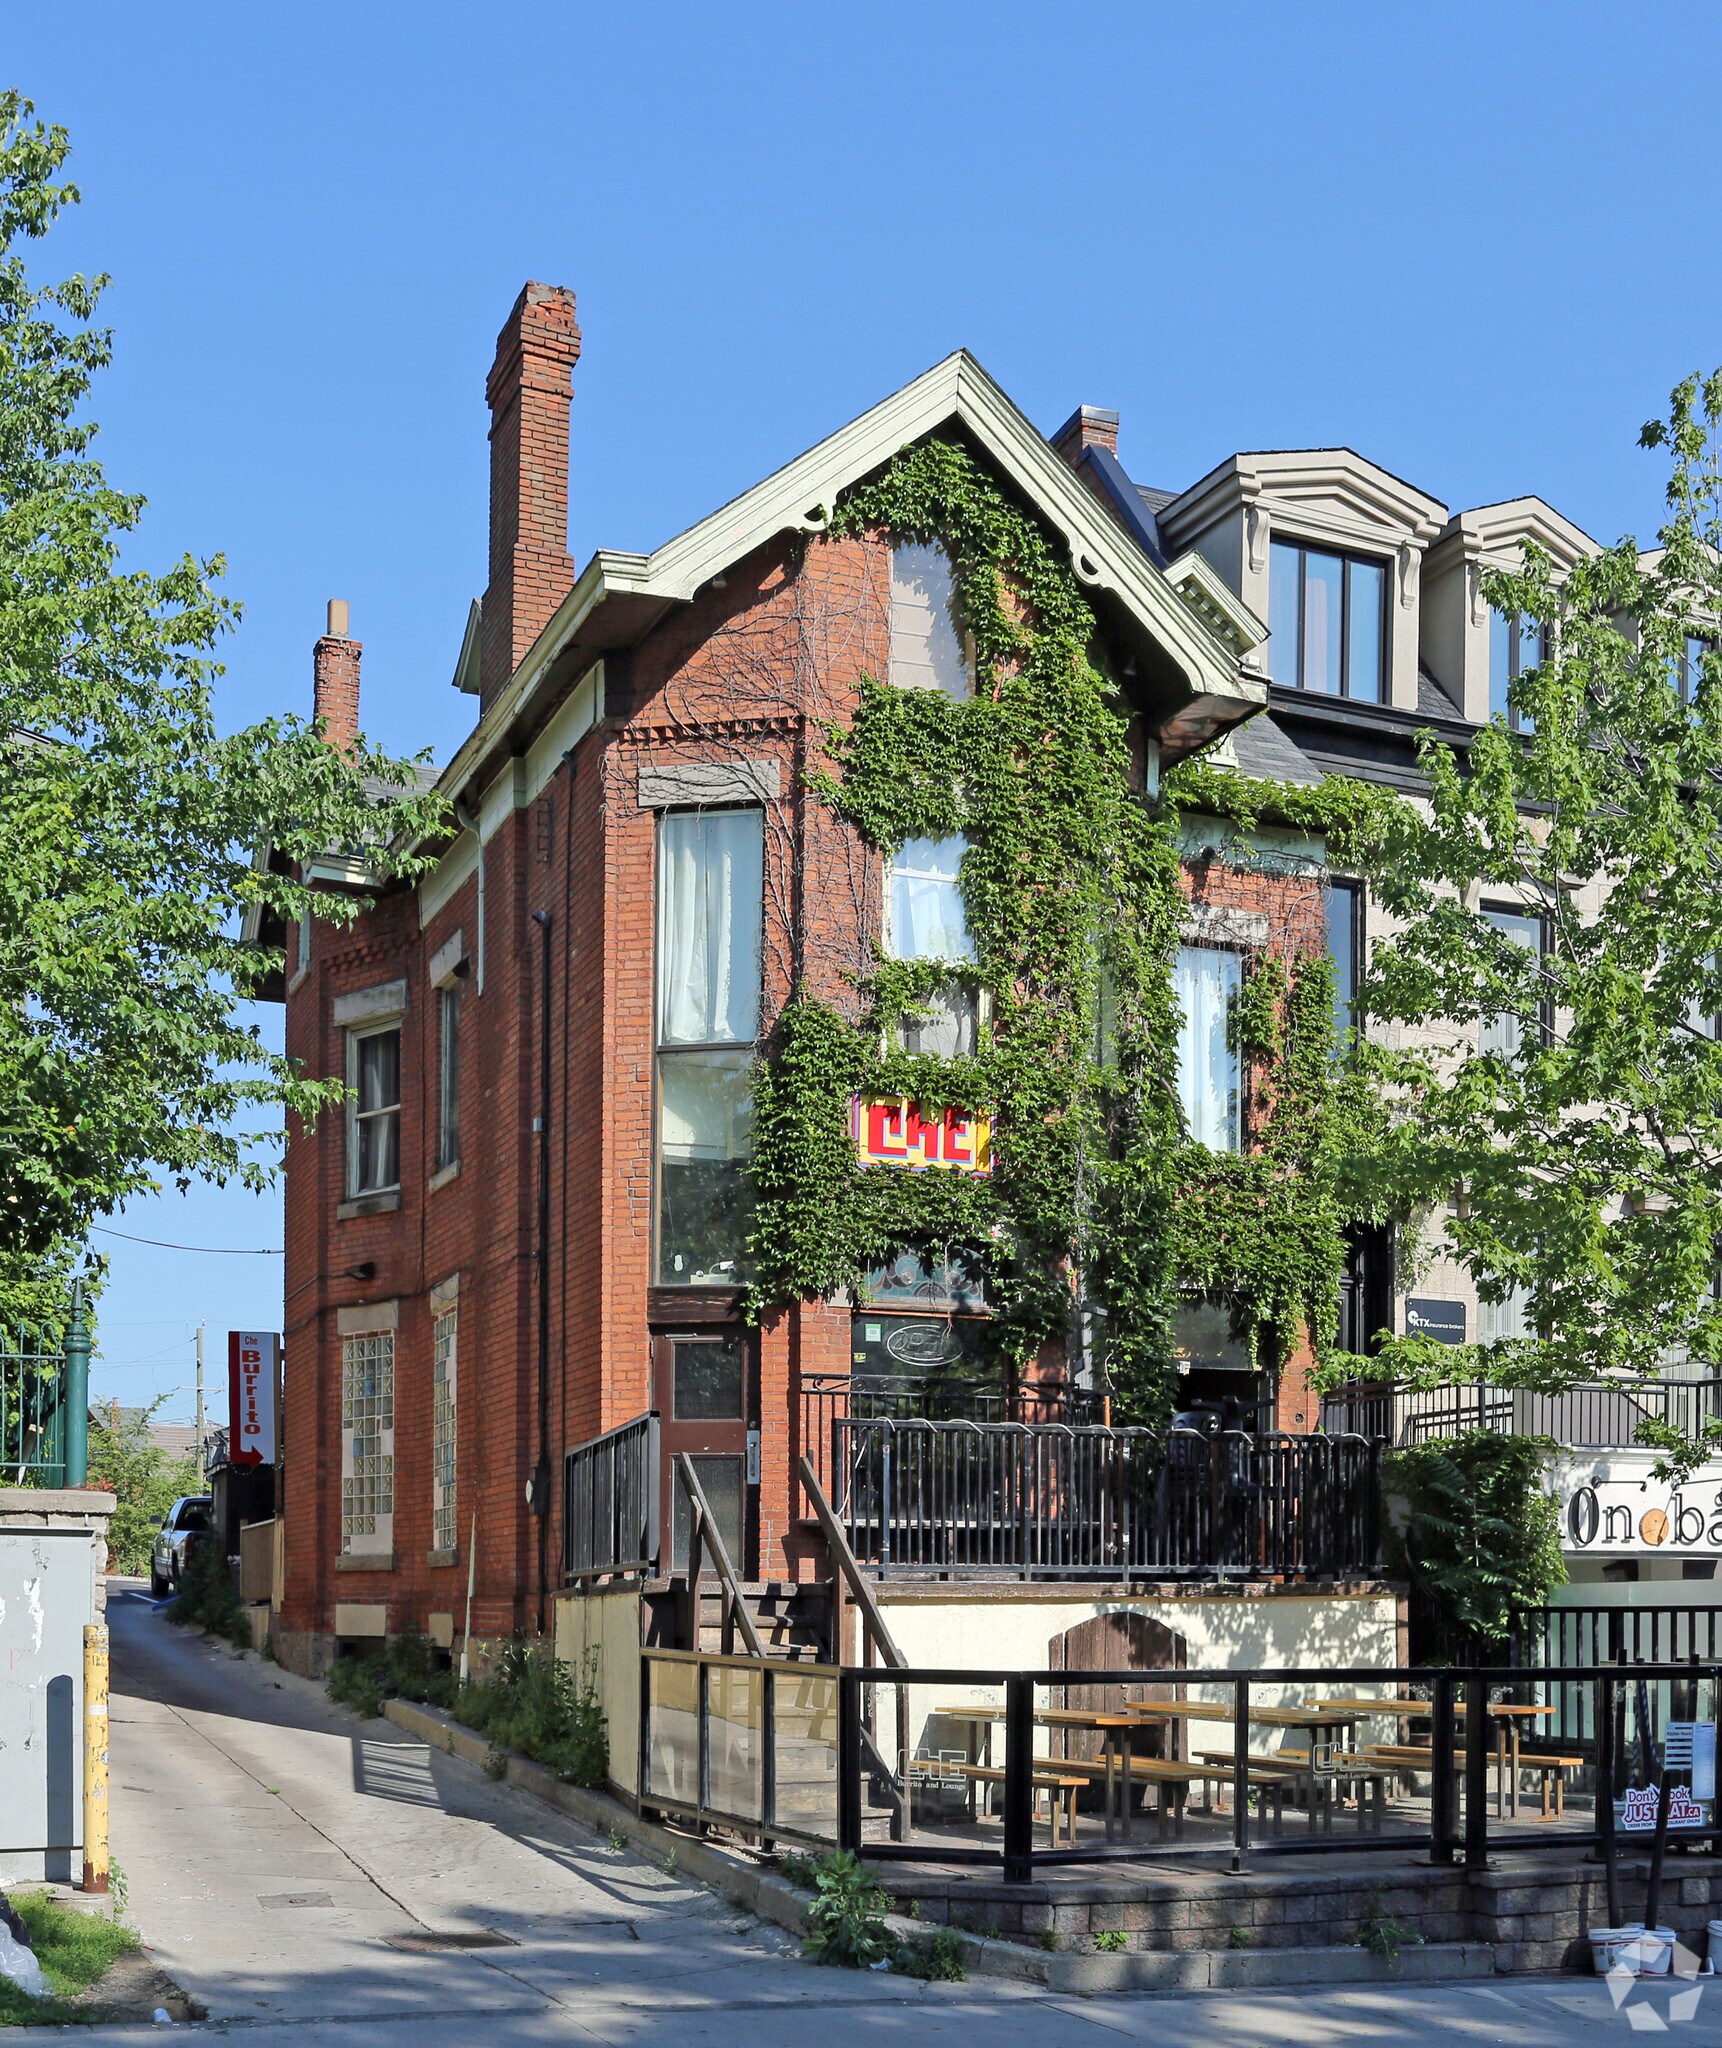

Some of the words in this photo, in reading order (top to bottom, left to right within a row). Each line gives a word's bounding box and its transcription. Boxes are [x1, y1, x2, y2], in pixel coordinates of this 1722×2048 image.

[1413, 1318, 1430, 1327] KTX
[244, 1336, 258, 1345] Che
[242, 1349, 261, 1435] Burrito
[897, 1780, 922, 1788] Burrito
[926, 1781, 939, 1789] and
[941, 1782, 966, 1791] Lounge
[1628, 1790, 1654, 1802] Don't
[1669, 1788, 1688, 1800] ook
[1625, 1803, 1658, 1821] JUST
